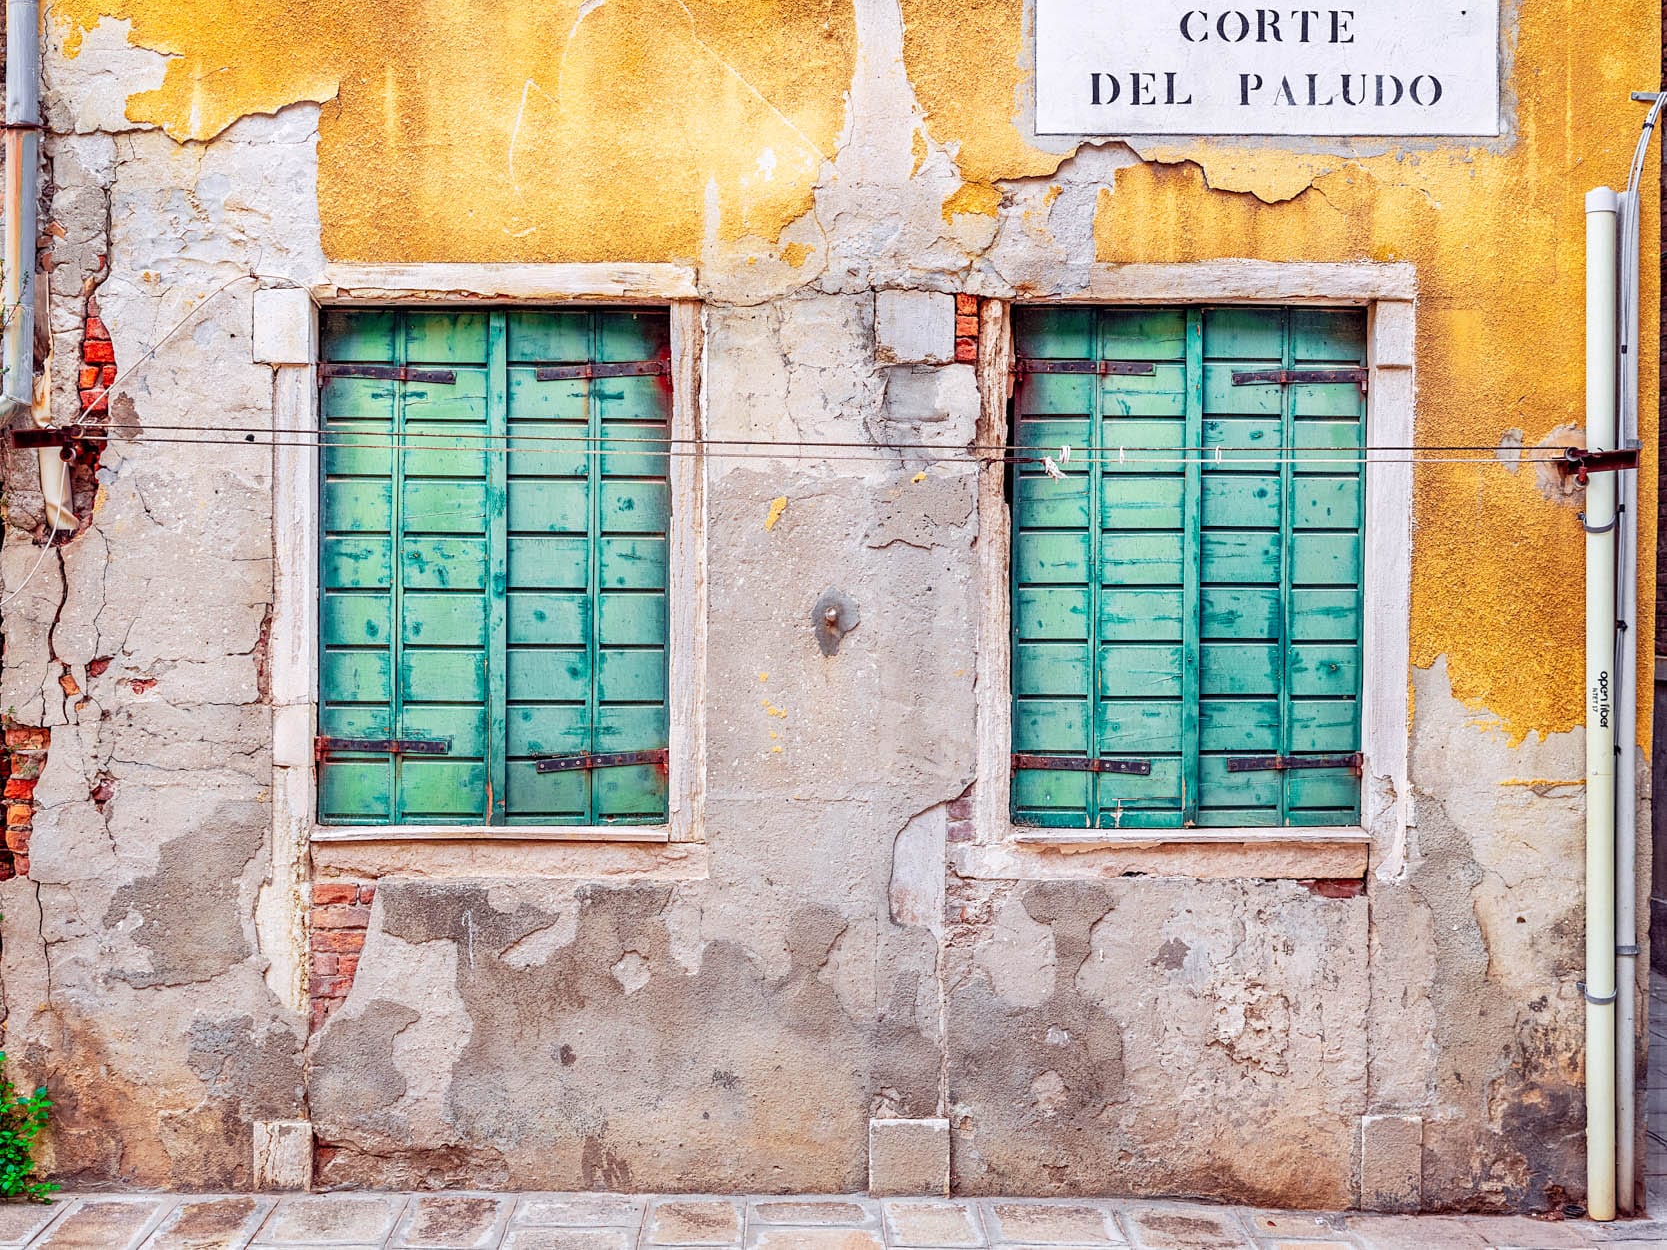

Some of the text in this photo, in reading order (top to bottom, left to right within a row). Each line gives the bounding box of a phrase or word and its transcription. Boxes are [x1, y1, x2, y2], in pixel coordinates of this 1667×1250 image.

[1179, 9, 1355, 44] CORTE
[1090, 72, 1443, 107] DEL PALUDO
[1598, 670, 1611, 728] open fiber
